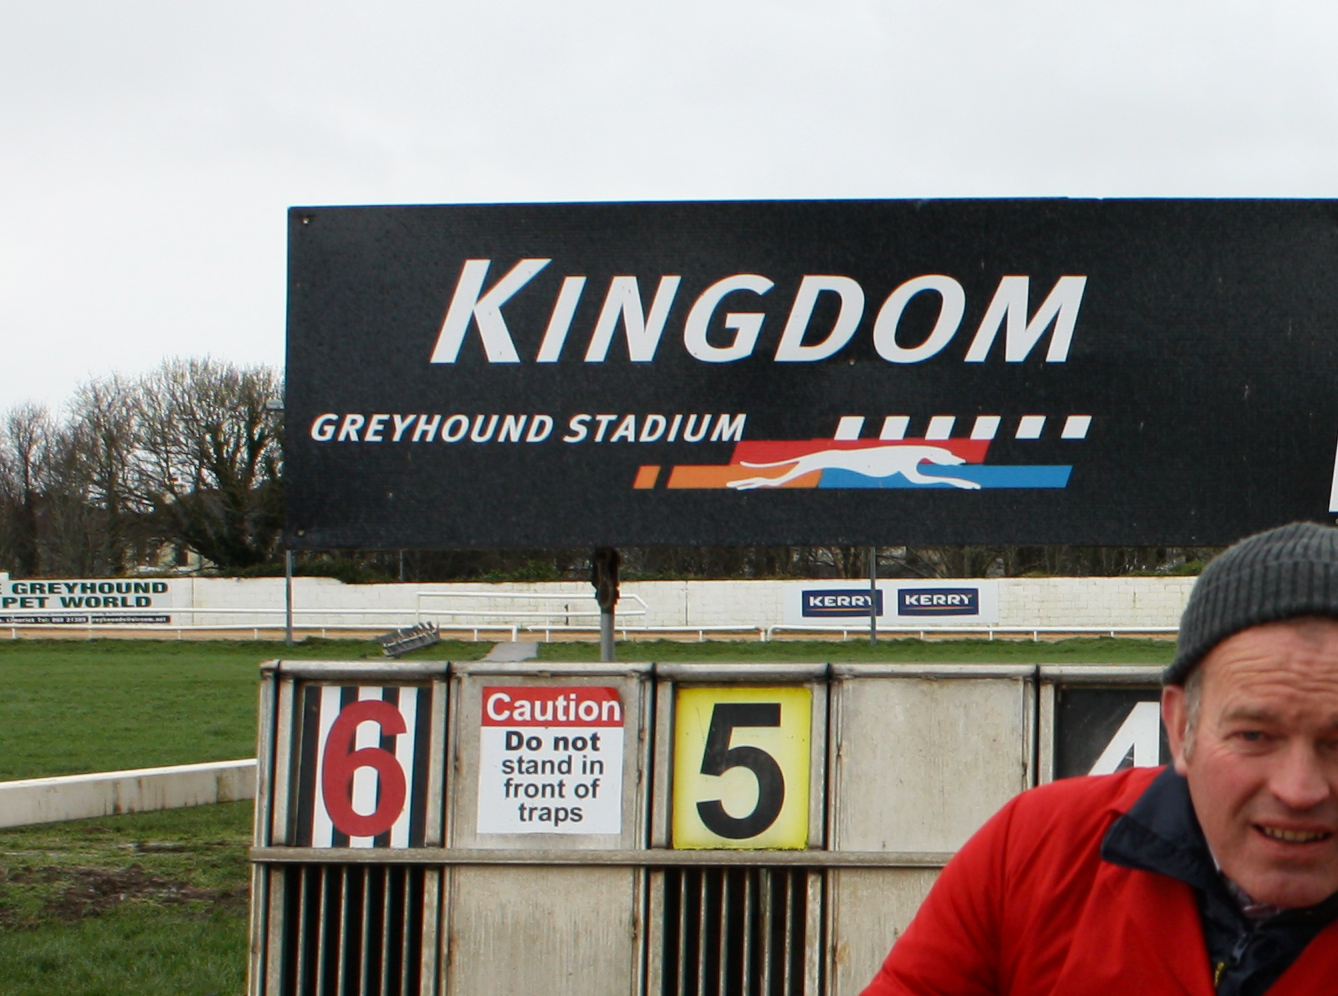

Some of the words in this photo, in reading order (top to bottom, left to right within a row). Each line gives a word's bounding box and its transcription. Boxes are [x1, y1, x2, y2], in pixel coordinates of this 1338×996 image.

[430, 258, 1087, 364] KINGDOM
[310, 413, 554, 443] GREYHOUND
[563, 413, 747, 443] STADIUM
[12, 582, 169, 595] GREYHOUND
[2, 596, 49, 609] PET
[60, 596, 152, 609] WORLD
[809, 595, 873, 607] KERRY
[905, 594, 973, 606] KERRY
[487, 693, 621, 722] Caution
[504, 731, 543, 751] Do
[552, 732, 600, 752] not
[323, 699, 407, 837] 6
[501, 755, 572, 776] stand
[582, 755, 605, 776] in
[696, 702, 785, 840] 5
[504, 778, 566, 799] front
[575, 778, 600, 799] of
[517, 803, 583, 825] traps
